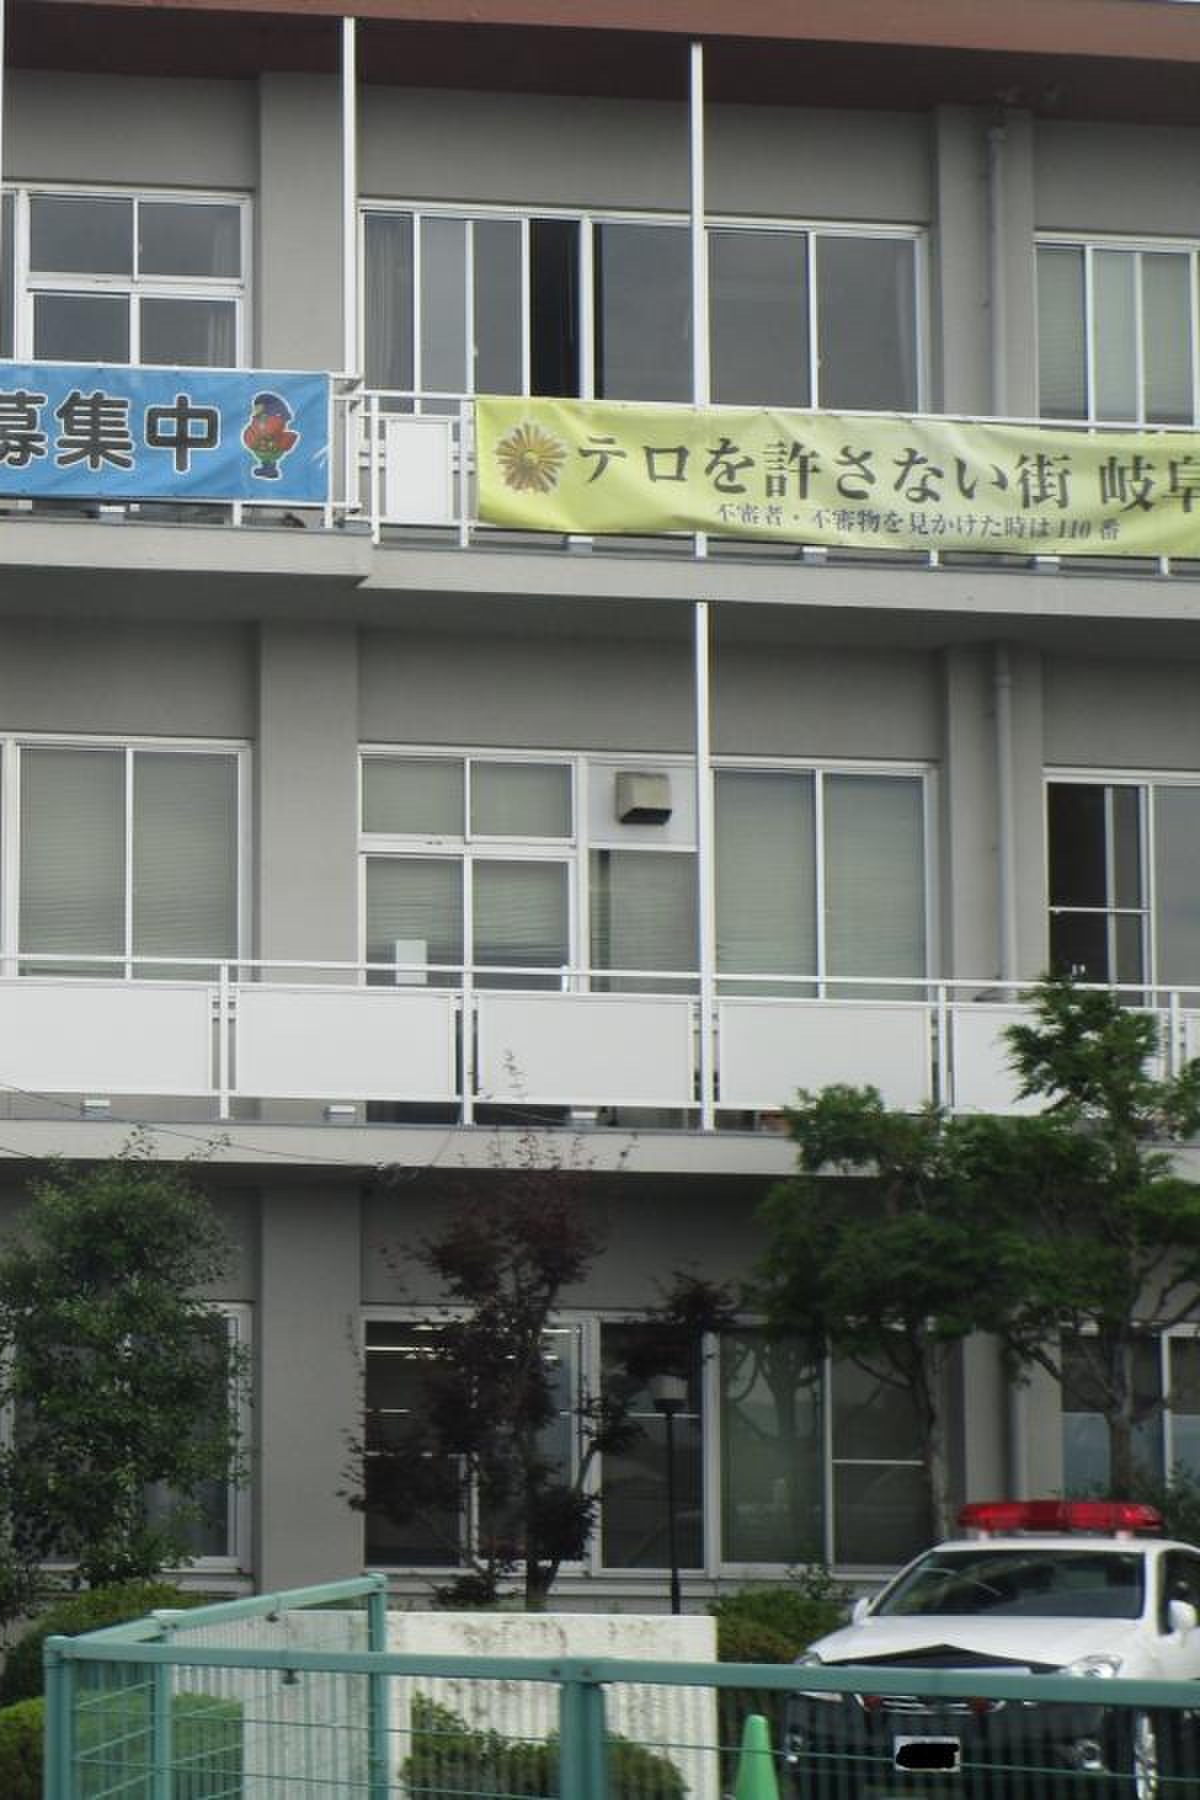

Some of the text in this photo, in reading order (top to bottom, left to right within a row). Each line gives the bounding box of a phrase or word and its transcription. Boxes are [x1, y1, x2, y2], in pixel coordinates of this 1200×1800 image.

[578, 436, 1072, 510] テロを許さない街
